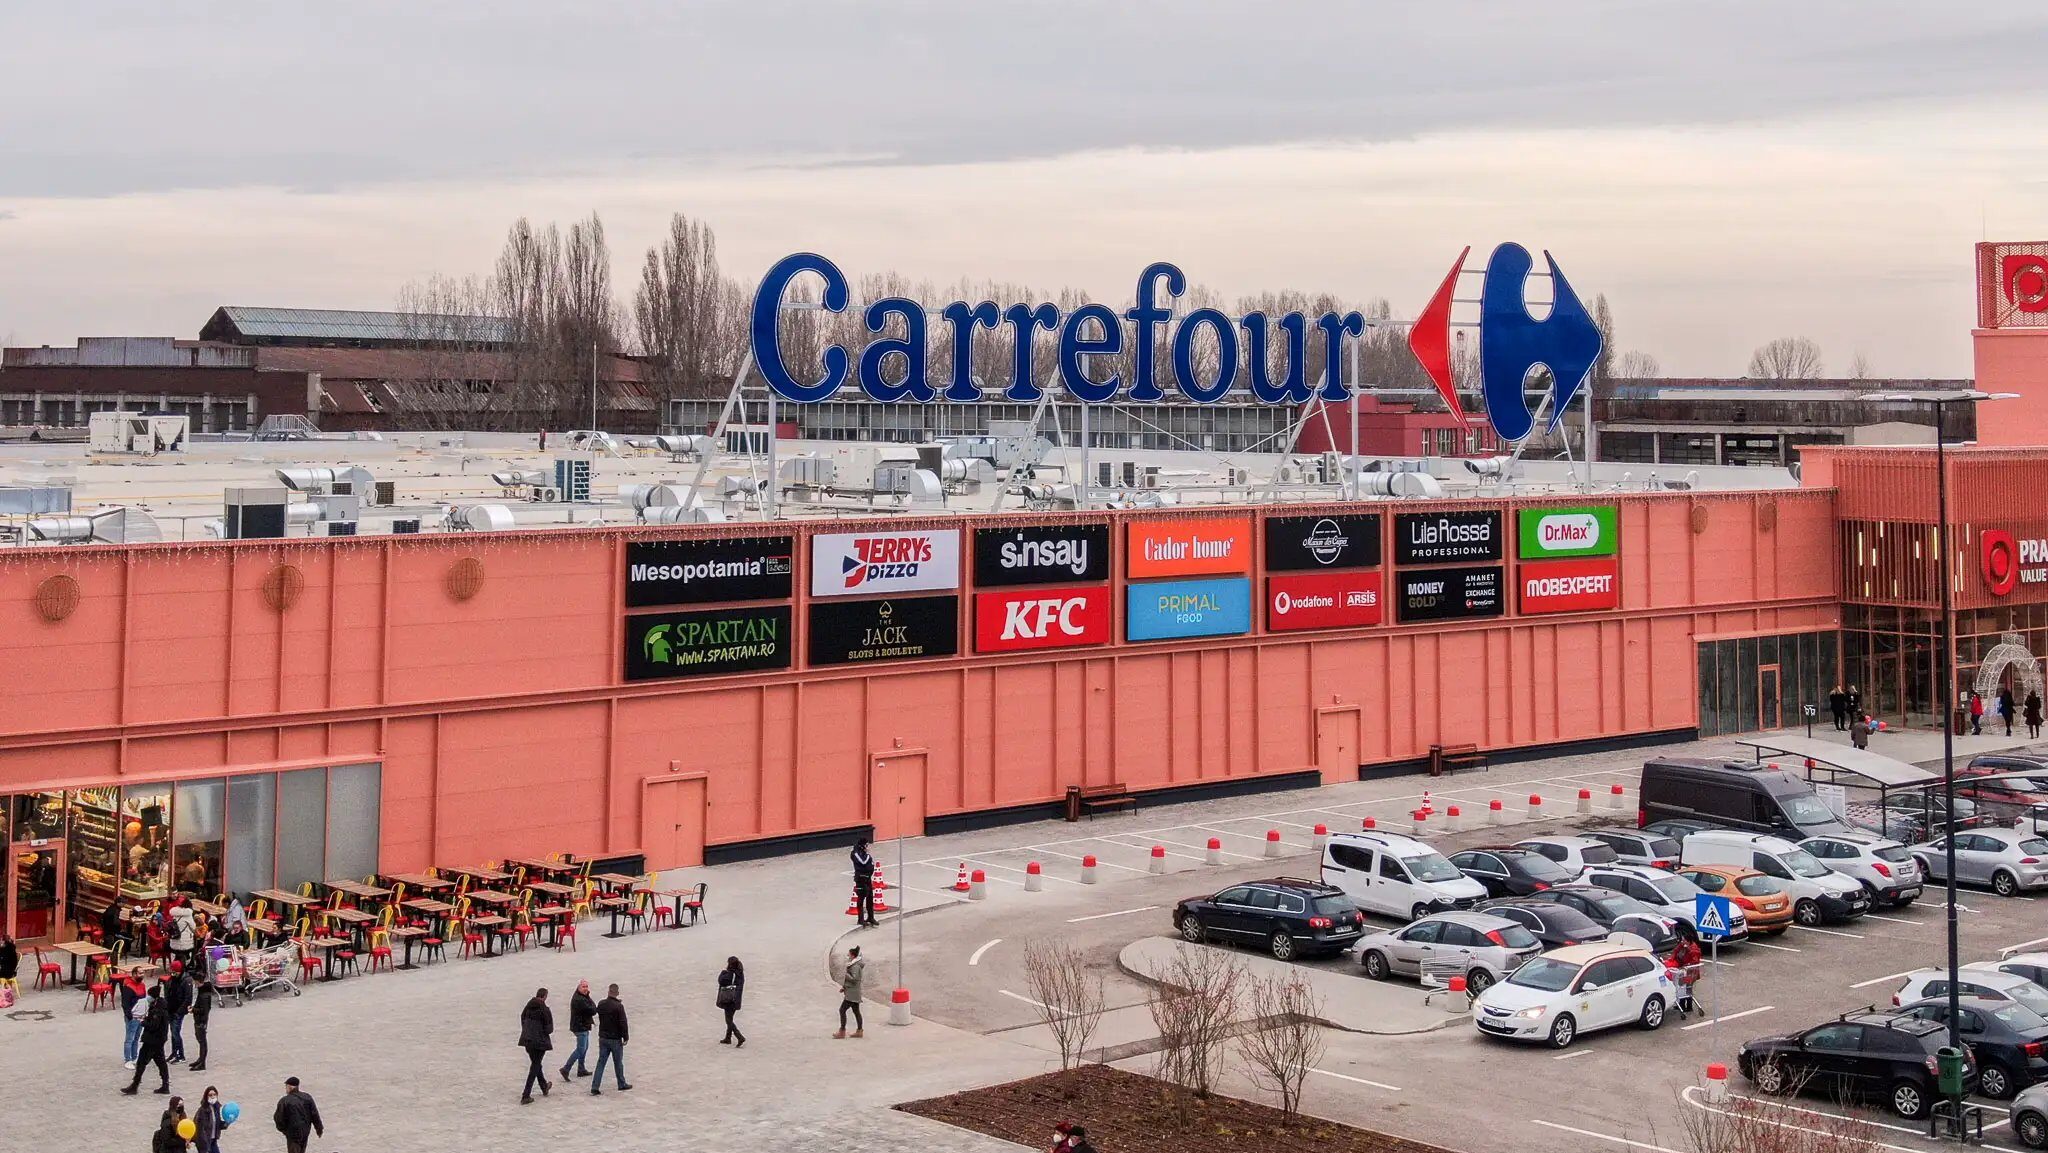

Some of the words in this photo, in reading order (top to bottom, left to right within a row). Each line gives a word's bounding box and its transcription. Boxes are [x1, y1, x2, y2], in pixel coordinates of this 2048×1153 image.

[750, 251, 1366, 403] Carrefour
[1412, 521, 1437, 544] Lila
[1439, 519, 1490, 543] Rossa
[1545, 524, 1587, 541] Dr.Max
[1000, 533, 1088, 575] sinsay
[1144, 537, 1188, 562] Cador
[1192, 535, 1231, 559] home
[1411, 547, 1491, 557] PROFESSIONAL
[631, 558, 761, 583] Mesopotamia
[866, 563, 919, 582] pizza
[1465, 574, 1495, 582] AMANET
[2020, 569, 2047, 583] VALUE
[1407, 582, 1445, 595] MONEY
[1465, 589, 1496, 597] EXCHANGE
[1526, 575, 1612, 598] MOBEXPERT
[1157, 594, 1220, 614] PRIMAL
[1292, 595, 1333, 609] vodafone
[1408, 596, 1437, 608] GOLD
[1000, 597, 1086, 640] KFC
[1176, 613, 1203, 624] FOOD
[676, 617, 777, 648] SPARTAN
[862, 626, 908, 646] JACK
[676, 642, 776, 666] WWW.SPARTAN.RO
[848, 649, 874, 659] SLOTS
[881, 645, 923, 657] ROULETTE
